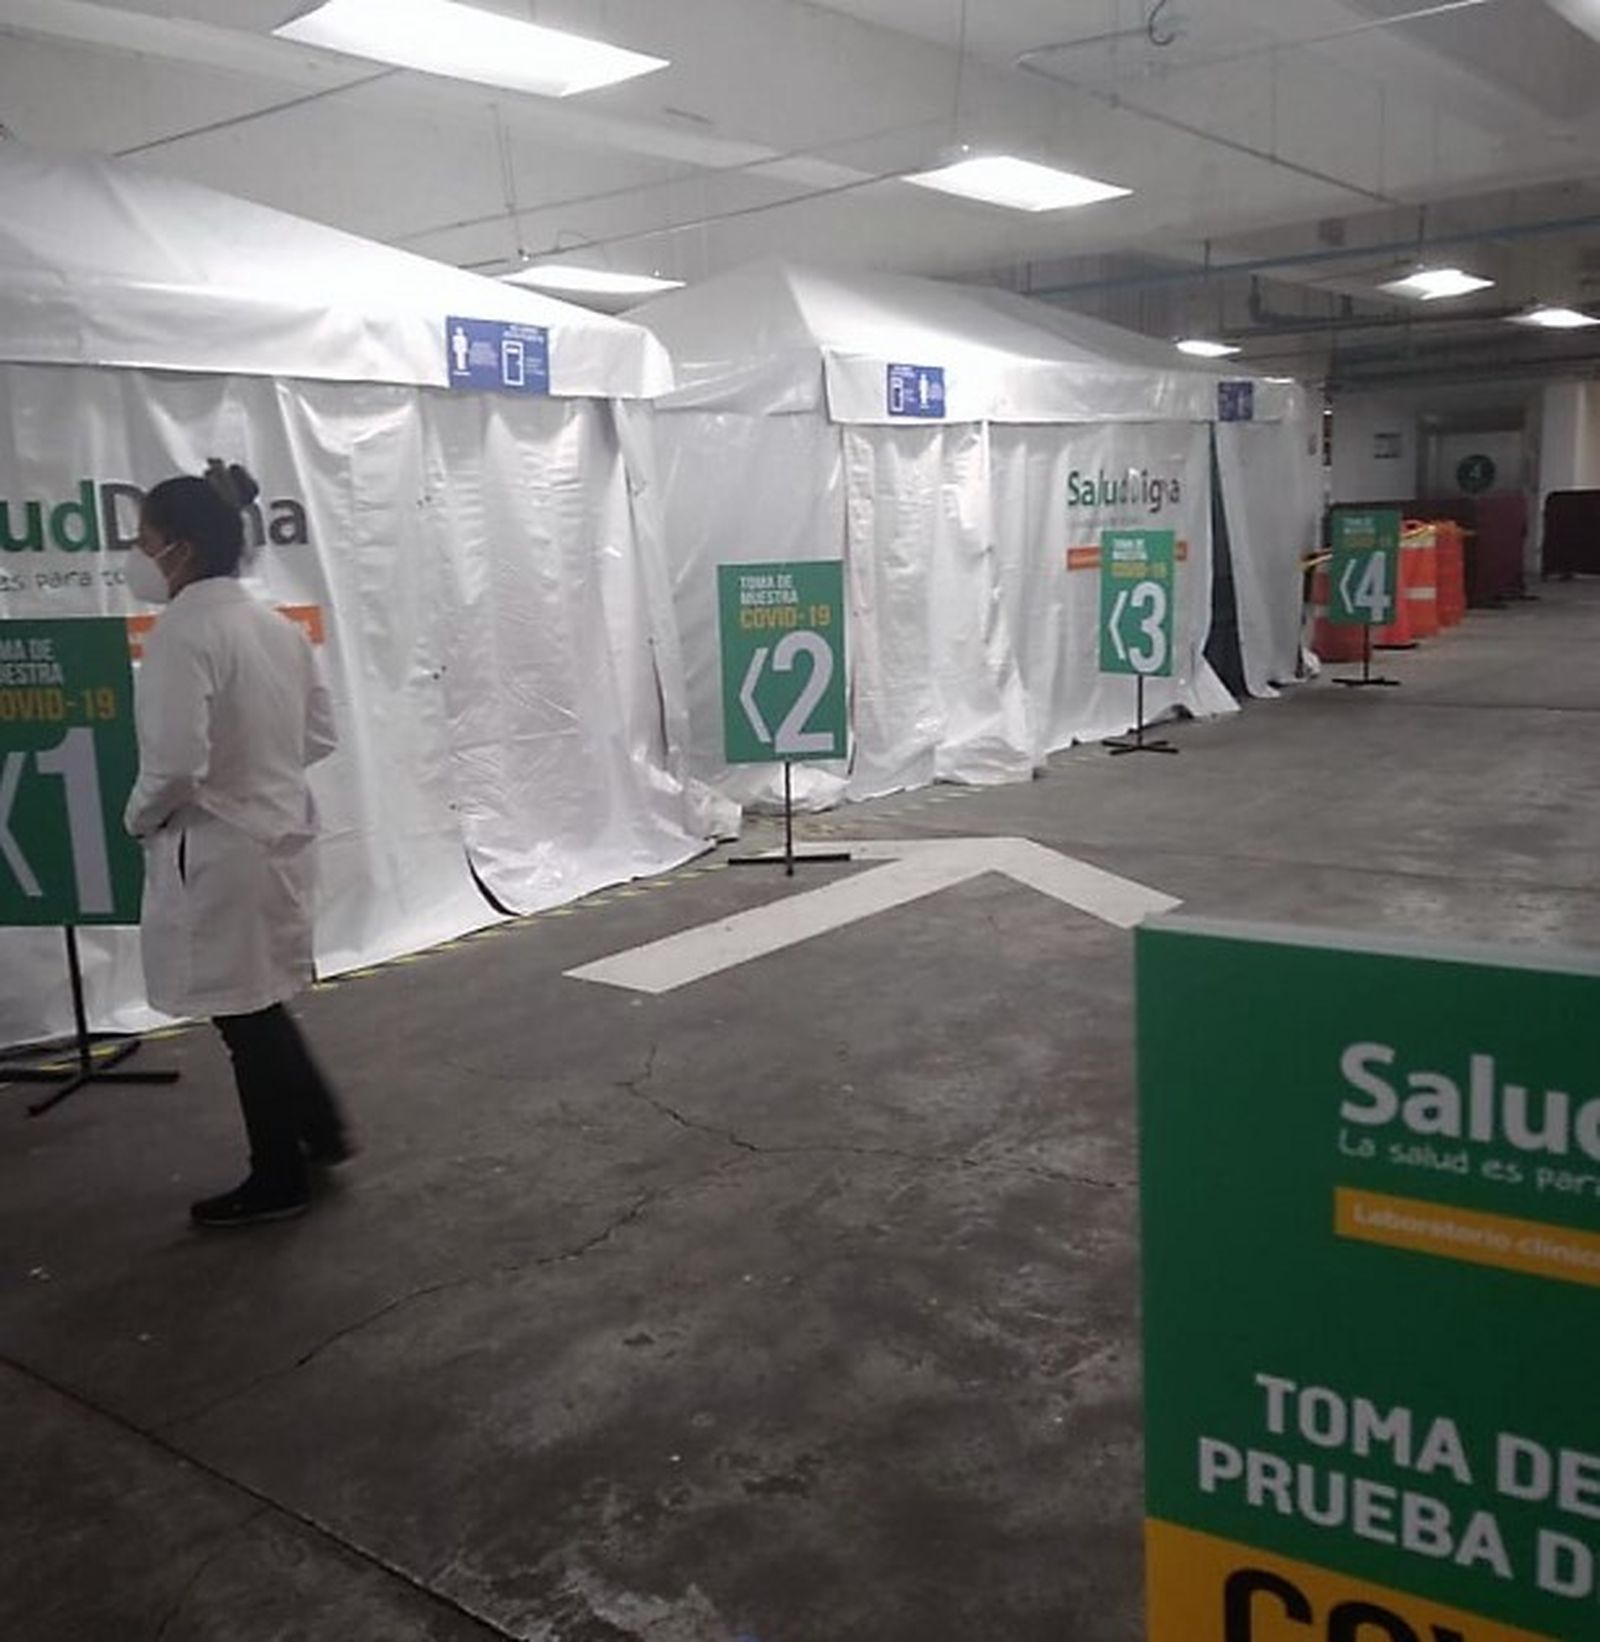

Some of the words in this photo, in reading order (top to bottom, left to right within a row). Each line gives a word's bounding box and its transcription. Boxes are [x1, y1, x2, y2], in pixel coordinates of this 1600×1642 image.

[740, 604, 832, 629] COVID-19
[1128, 581, 1167, 672] 3
[1354, 551, 1391, 622] 4
[772, 630, 834, 753] 2
[35, 728, 115, 914] 1
[1338, 1127, 1377, 1158] La
[1388, 1141, 1470, 1175] salud
[1480, 1158, 1524, 1184] es
[1536, 1166, 1600, 1198] par
[1254, 1373, 1474, 1485] TOMA
[1199, 1436, 1514, 1581] PRUEBA
